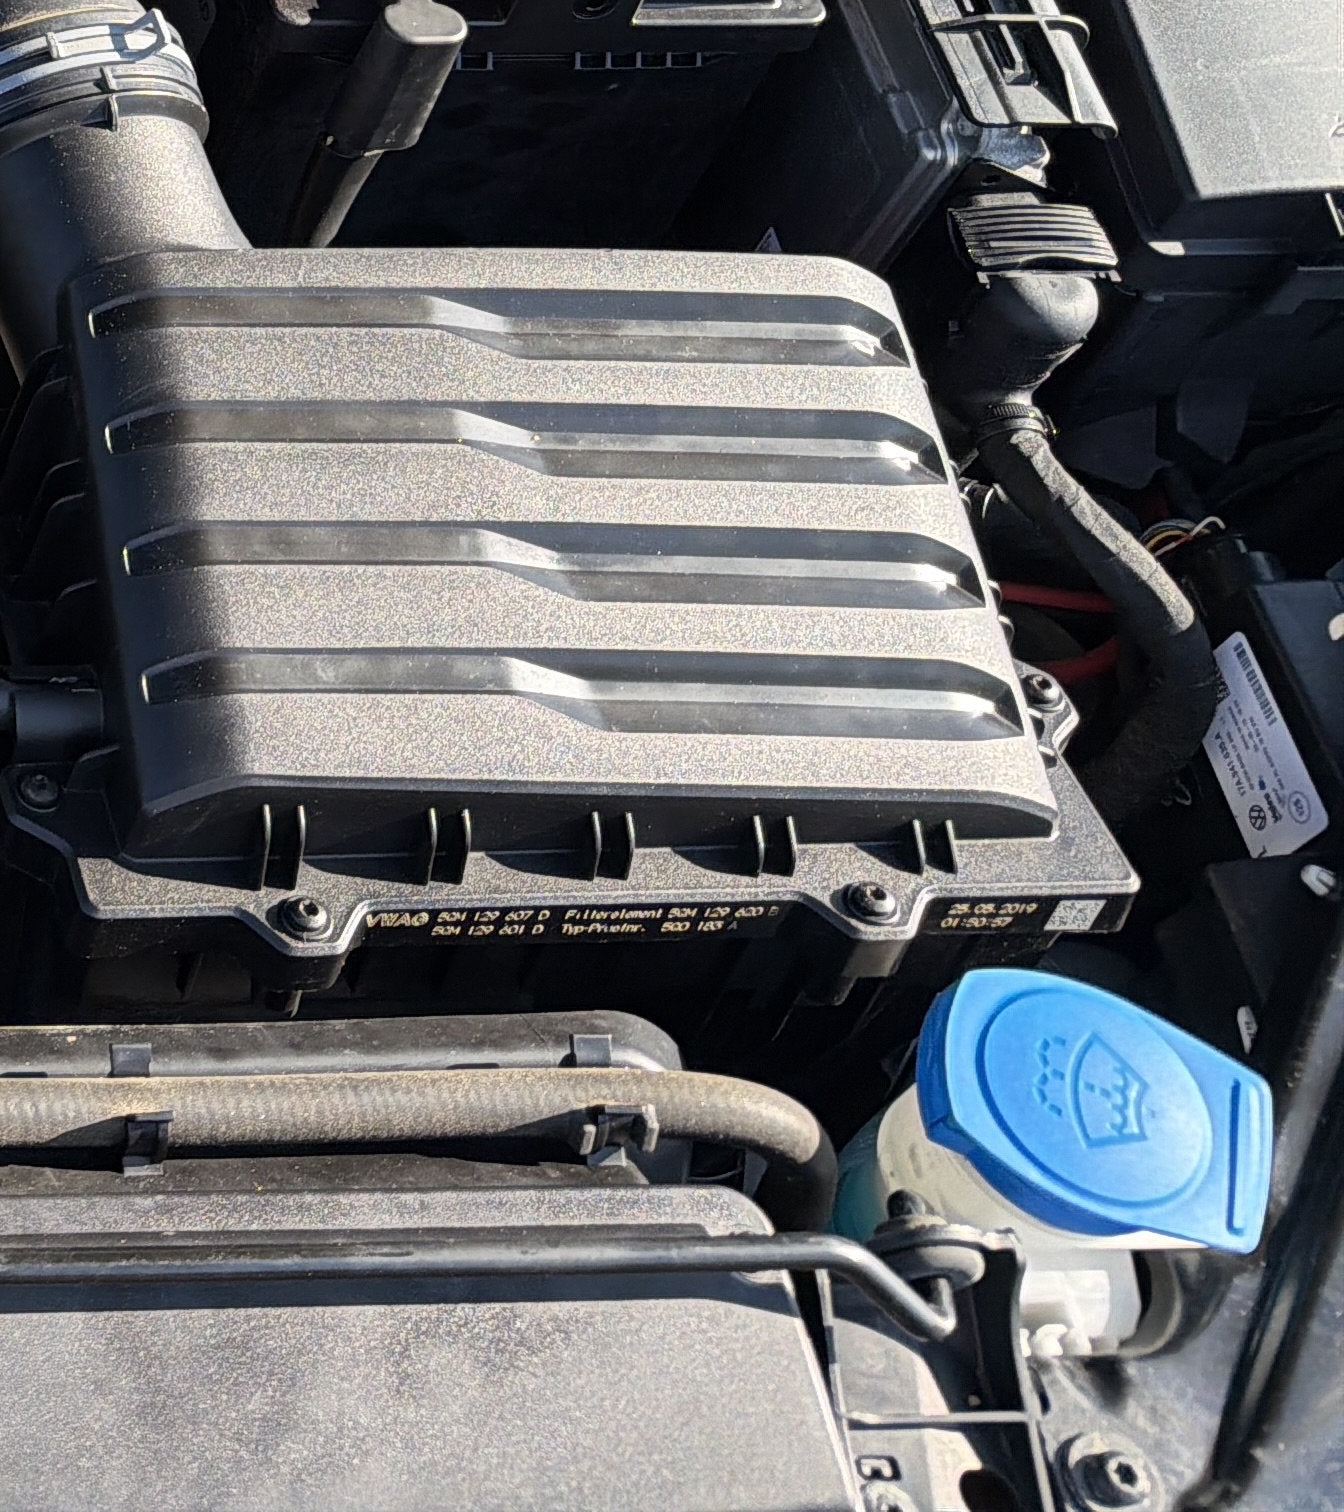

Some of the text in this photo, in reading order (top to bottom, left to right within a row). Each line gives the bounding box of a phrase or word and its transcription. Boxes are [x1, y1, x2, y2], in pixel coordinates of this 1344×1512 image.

[473, 910, 500, 922] 129
[504, 910, 534, 921] 607
[538, 910, 551, 921] D
[564, 908, 663, 920] Filterelement
[704, 906, 730, 917] 129
[734, 906, 764, 918] 620
[468, 925, 495, 936] 129
[498, 924, 525, 935] 601
[531, 924, 545, 935] D
[697, 920, 724, 932] 183
[726, 920, 738, 931] A
